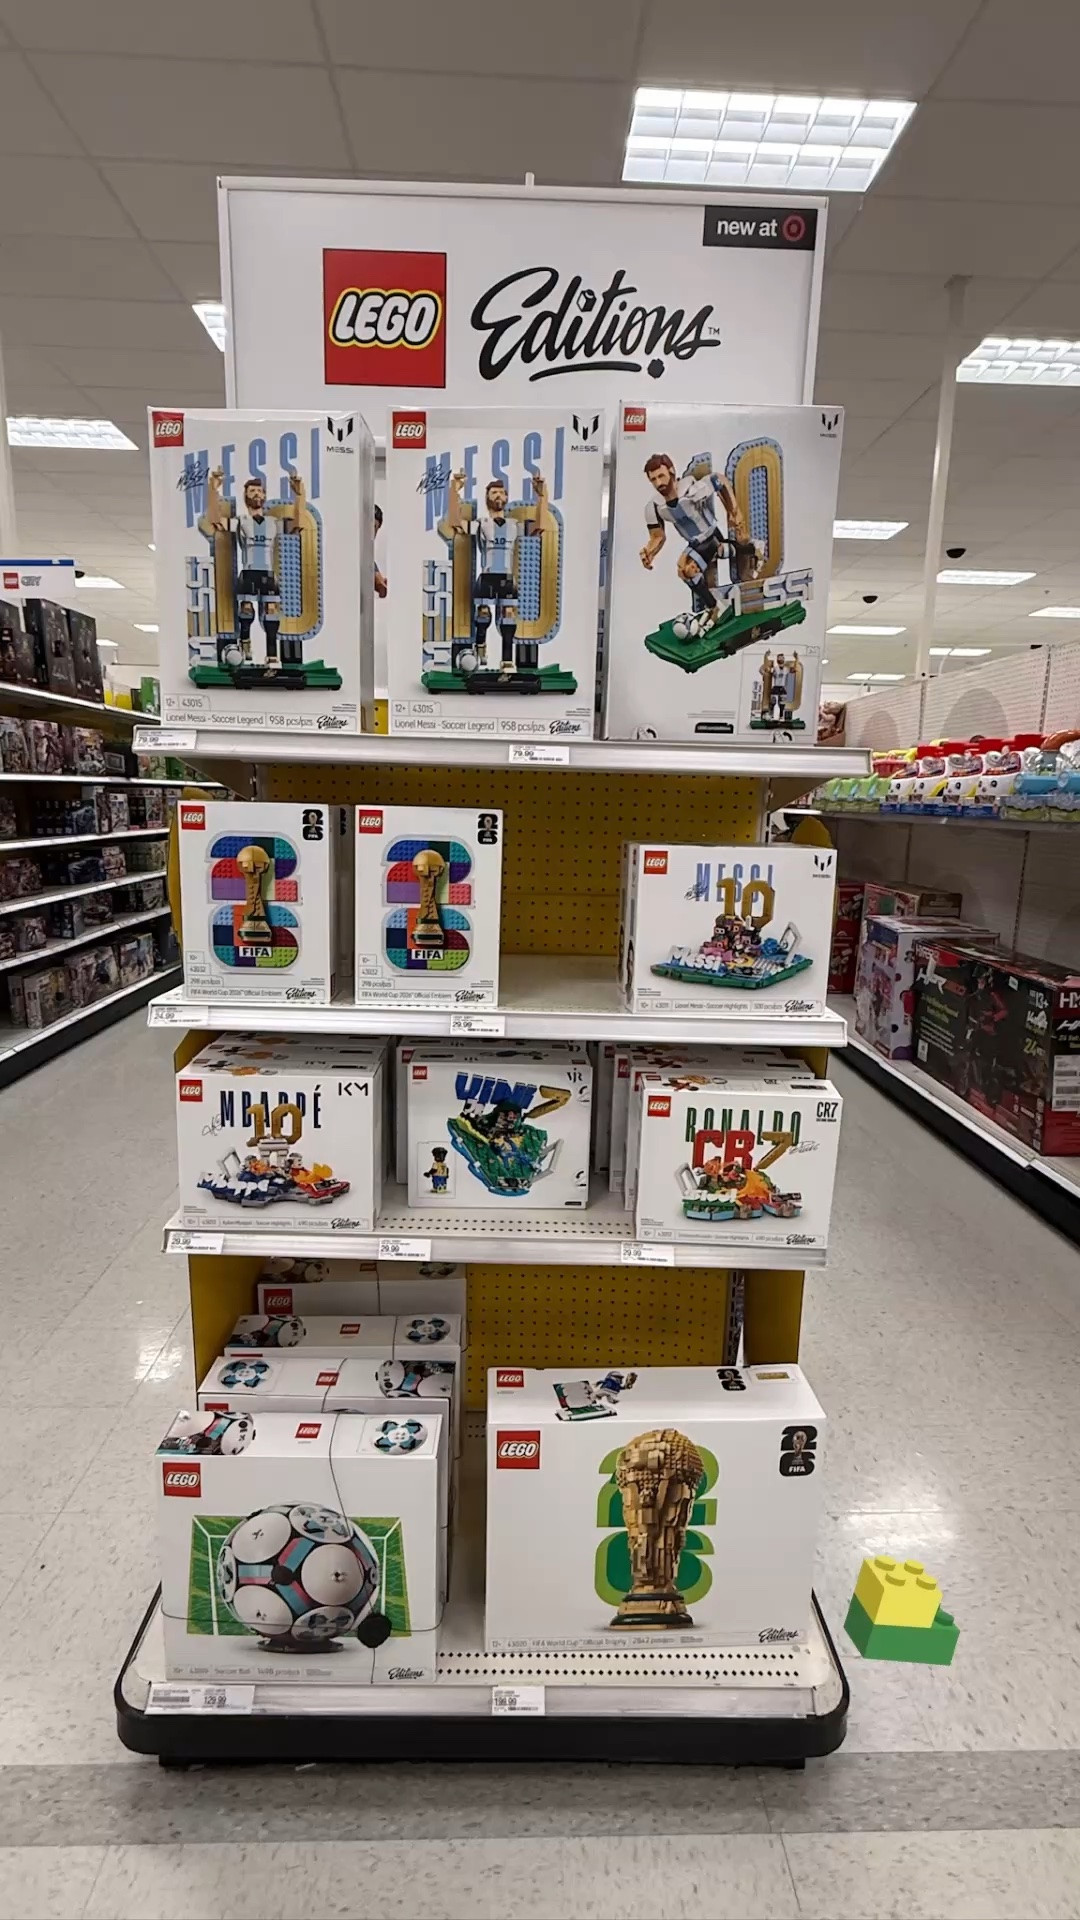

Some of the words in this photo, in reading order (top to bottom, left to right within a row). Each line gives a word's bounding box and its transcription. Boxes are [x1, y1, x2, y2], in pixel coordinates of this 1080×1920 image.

[717, 218, 751, 237] new
[755, 219, 778, 238] at
[331, 288, 442, 348] LEGO
[471, 266, 720, 381] Editions
[626, 415, 645, 424] LEGO
[155, 420, 182, 437] LEGO
[396, 422, 424, 439] LEGO
[326, 445, 354, 454] MESSI
[184, 428, 320, 528] MESSI
[426, 427, 565, 531] MESSI
[166, 713, 187, 723] Lionel
[187, 714, 206, 723] Messi
[212, 715, 235, 725] Soccer
[237, 716, 264, 727] Legend
[269, 717, 285, 726] 958
[317, 715, 349, 730] Editions
[395, 720, 416, 730] Lionel
[417, 721, 436, 730] Messi
[442, 721, 466, 730] Soccer
[467, 722, 494, 732] Legend
[501, 721, 516, 731] 958
[549, 719, 583, 735] Editions
[182, 812, 203, 823] LEGO
[361, 816, 382, 827] LEGO
[645, 857, 667, 868] LEGO
[242, 948, 270, 957] FIFA
[415, 950, 442, 959] FIFA
[285, 988, 317, 1000] Editions
[454, 990, 485, 1003] Editions
[784, 1000, 815, 1013] Editions
[181, 1086, 201, 1096] LEGO
[650, 1101, 670, 1111] LEGO
[817, 1101, 839, 1118] CR7
[246, 1103, 304, 1147] 10
[685, 1107, 801, 1147] RONALDO
[692, 1130, 794, 1171] CR7
[331, 1217, 361, 1229] Editions
[786, 1233, 816, 1246] Editions
[266, 1296, 291, 1308] LEGO
[499, 1374, 522, 1383] LEGO
[298, 1427, 319, 1436] LEGO
[499, 1442, 540, 1459] LEGO
[165, 1472, 201, 1488] LEGO
[758, 1626, 799, 1643] Editions
[388, 1667, 424, 1681] Editions
